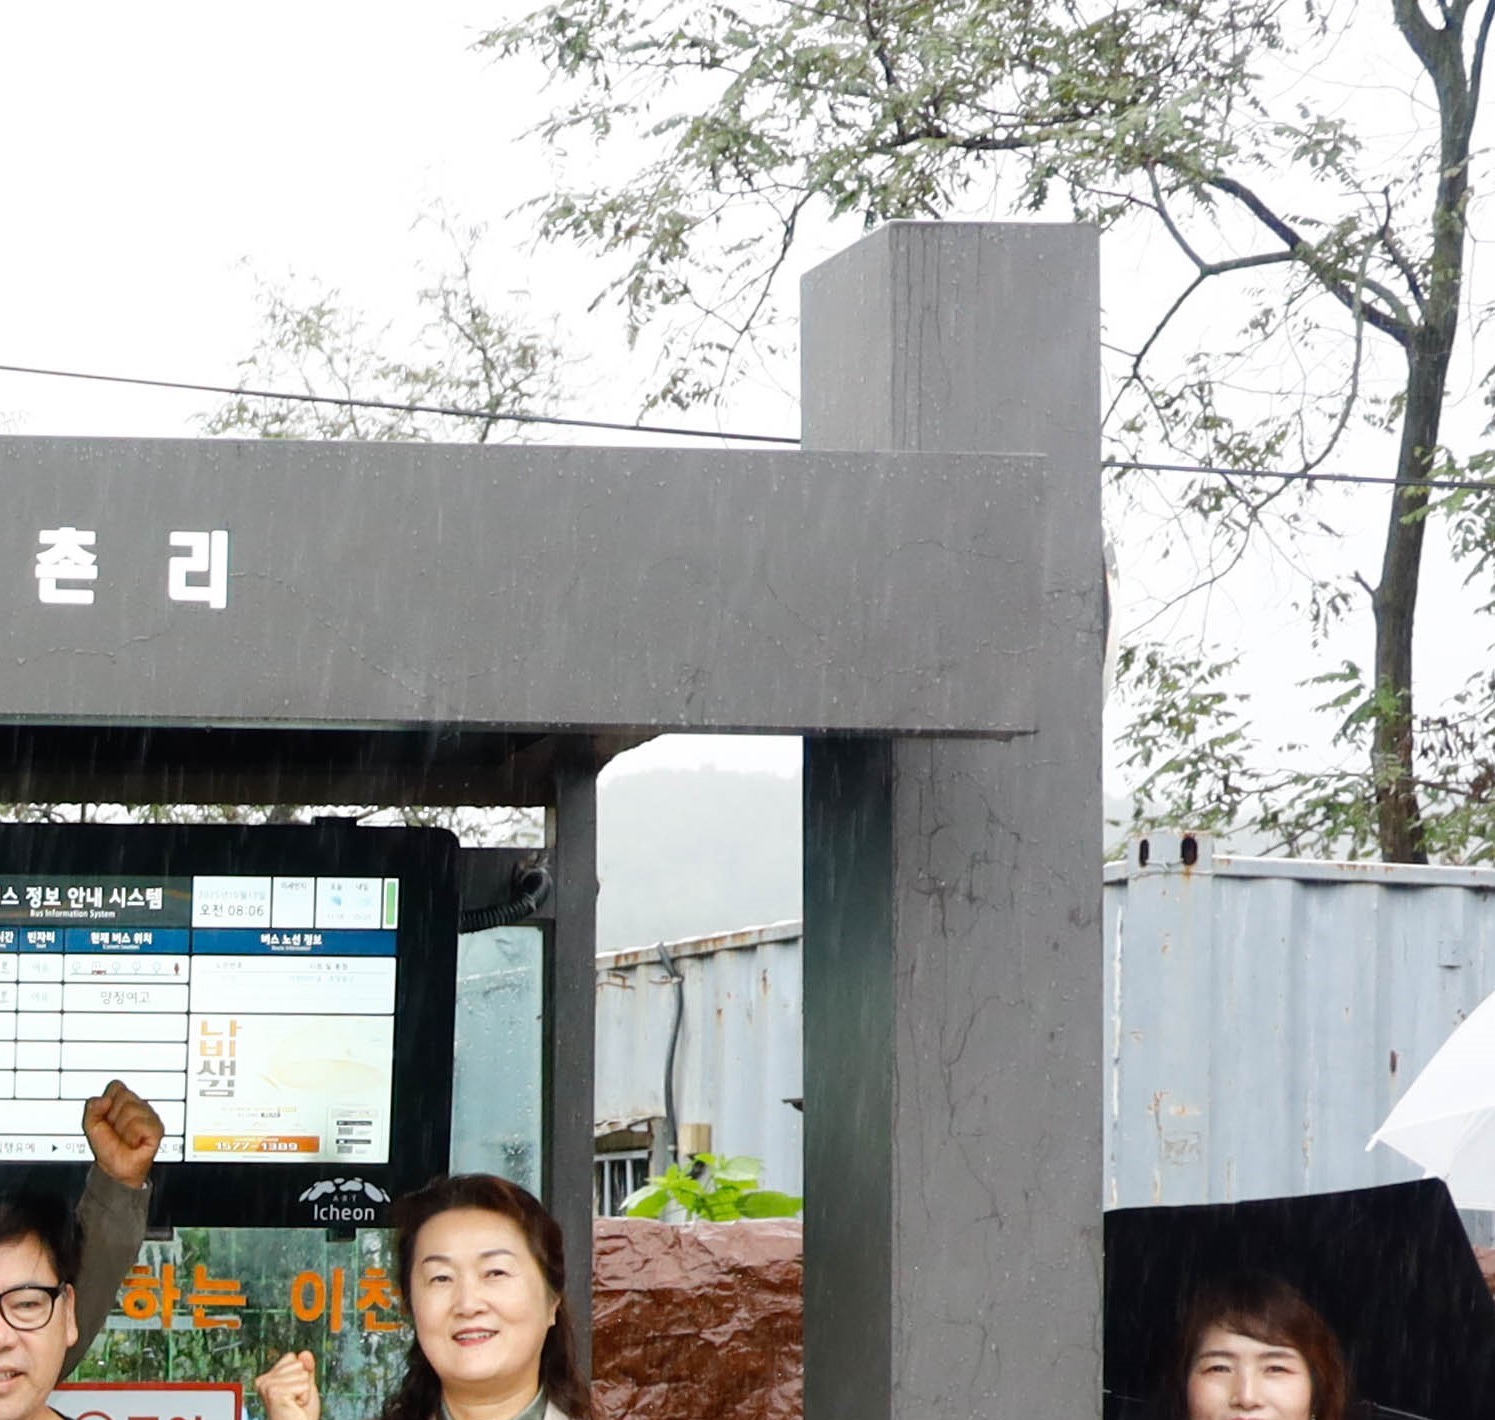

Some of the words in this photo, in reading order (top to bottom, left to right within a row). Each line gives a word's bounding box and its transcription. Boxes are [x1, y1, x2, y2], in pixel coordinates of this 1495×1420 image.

[25, 886, 61, 908] 정보
[67, 886, 103, 909] 안내
[109, 887, 163, 910] 시스템
[199, 904, 223, 917] 오전
[228, 904, 264, 917] 08:06
[312, 1203, 375, 1221] Icheon
